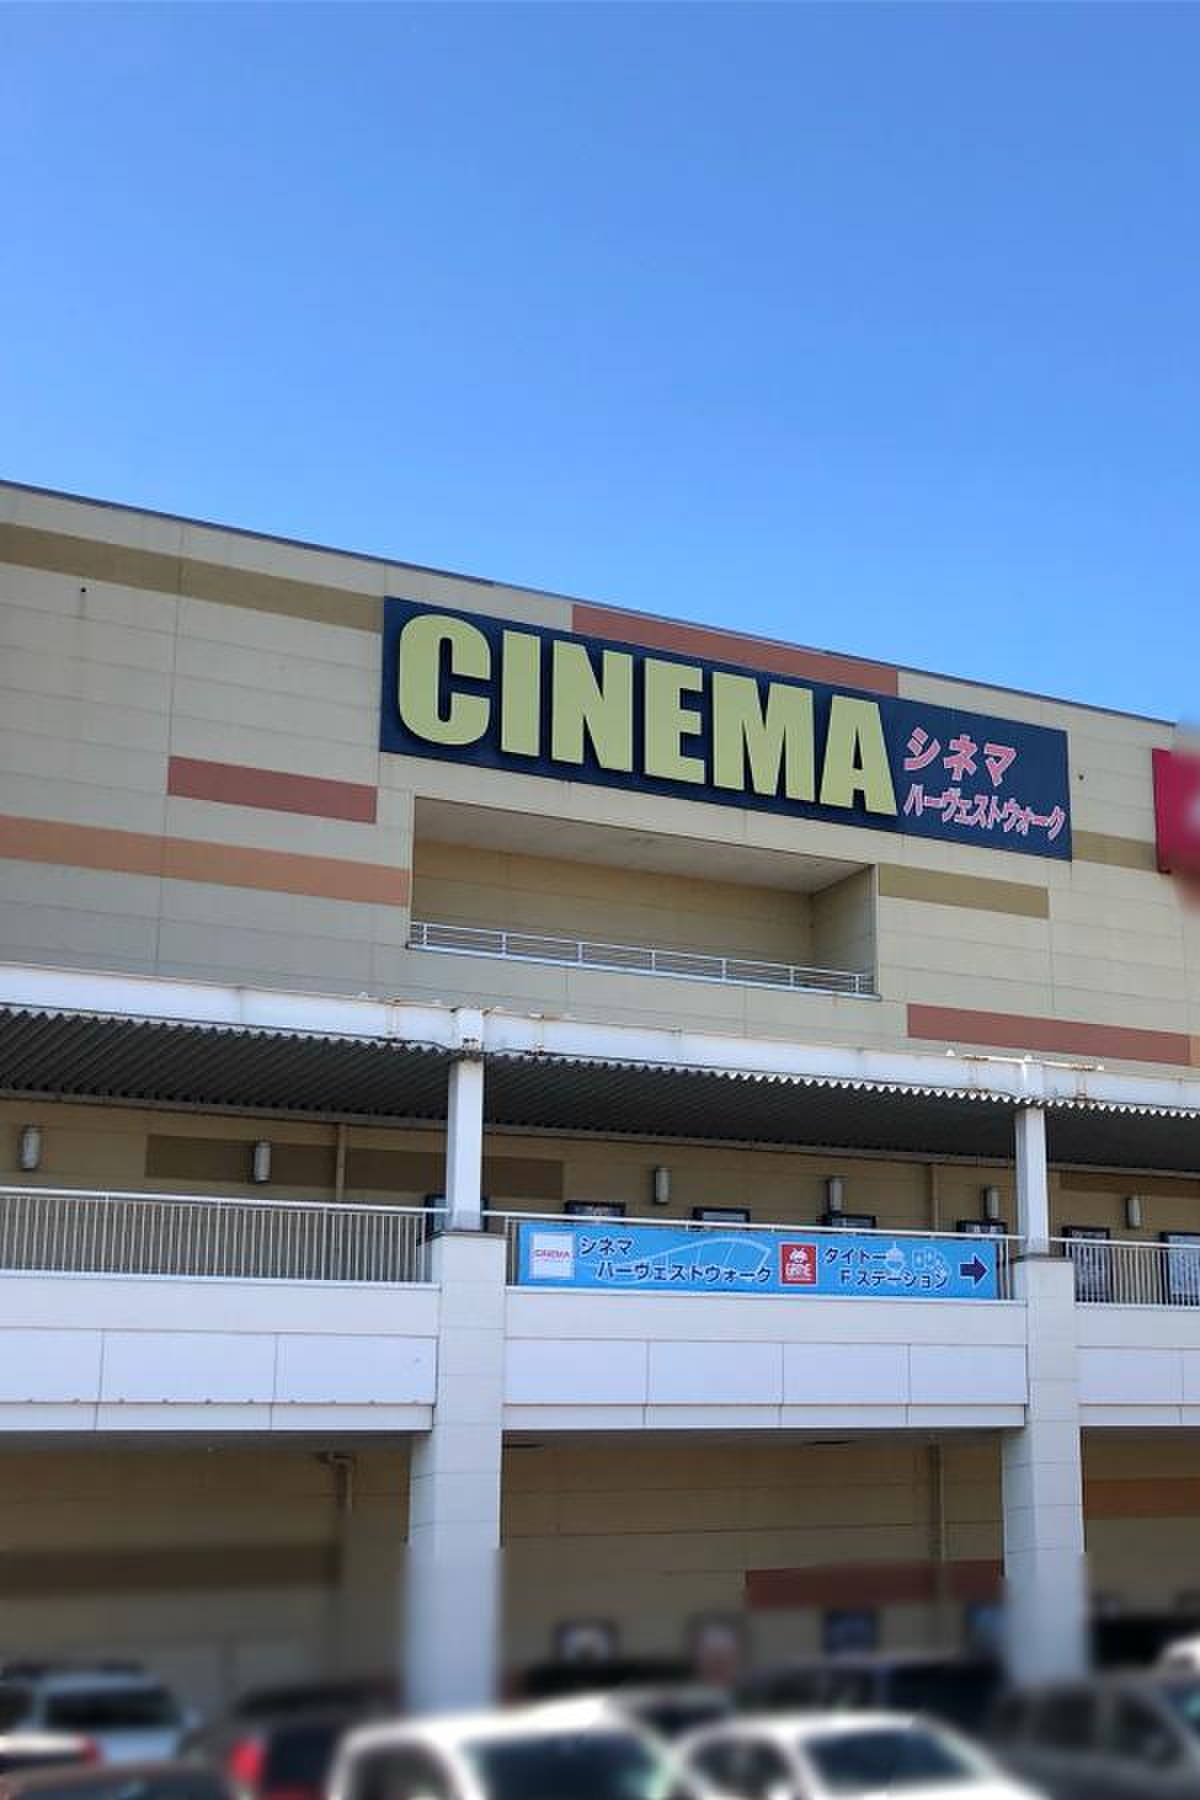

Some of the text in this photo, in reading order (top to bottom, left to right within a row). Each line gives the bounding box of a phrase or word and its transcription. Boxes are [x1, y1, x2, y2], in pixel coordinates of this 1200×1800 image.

[399, 613, 898, 816] CINEMA
[904, 727, 1017, 786] シネマ
[903, 784, 1066, 840] ハーヴェストウォーク
[580, 1237, 633, 1256] シネマ
[824, 1247, 888, 1265] タイトー
[597, 1261, 771, 1283] ハーヴェストウォーク
